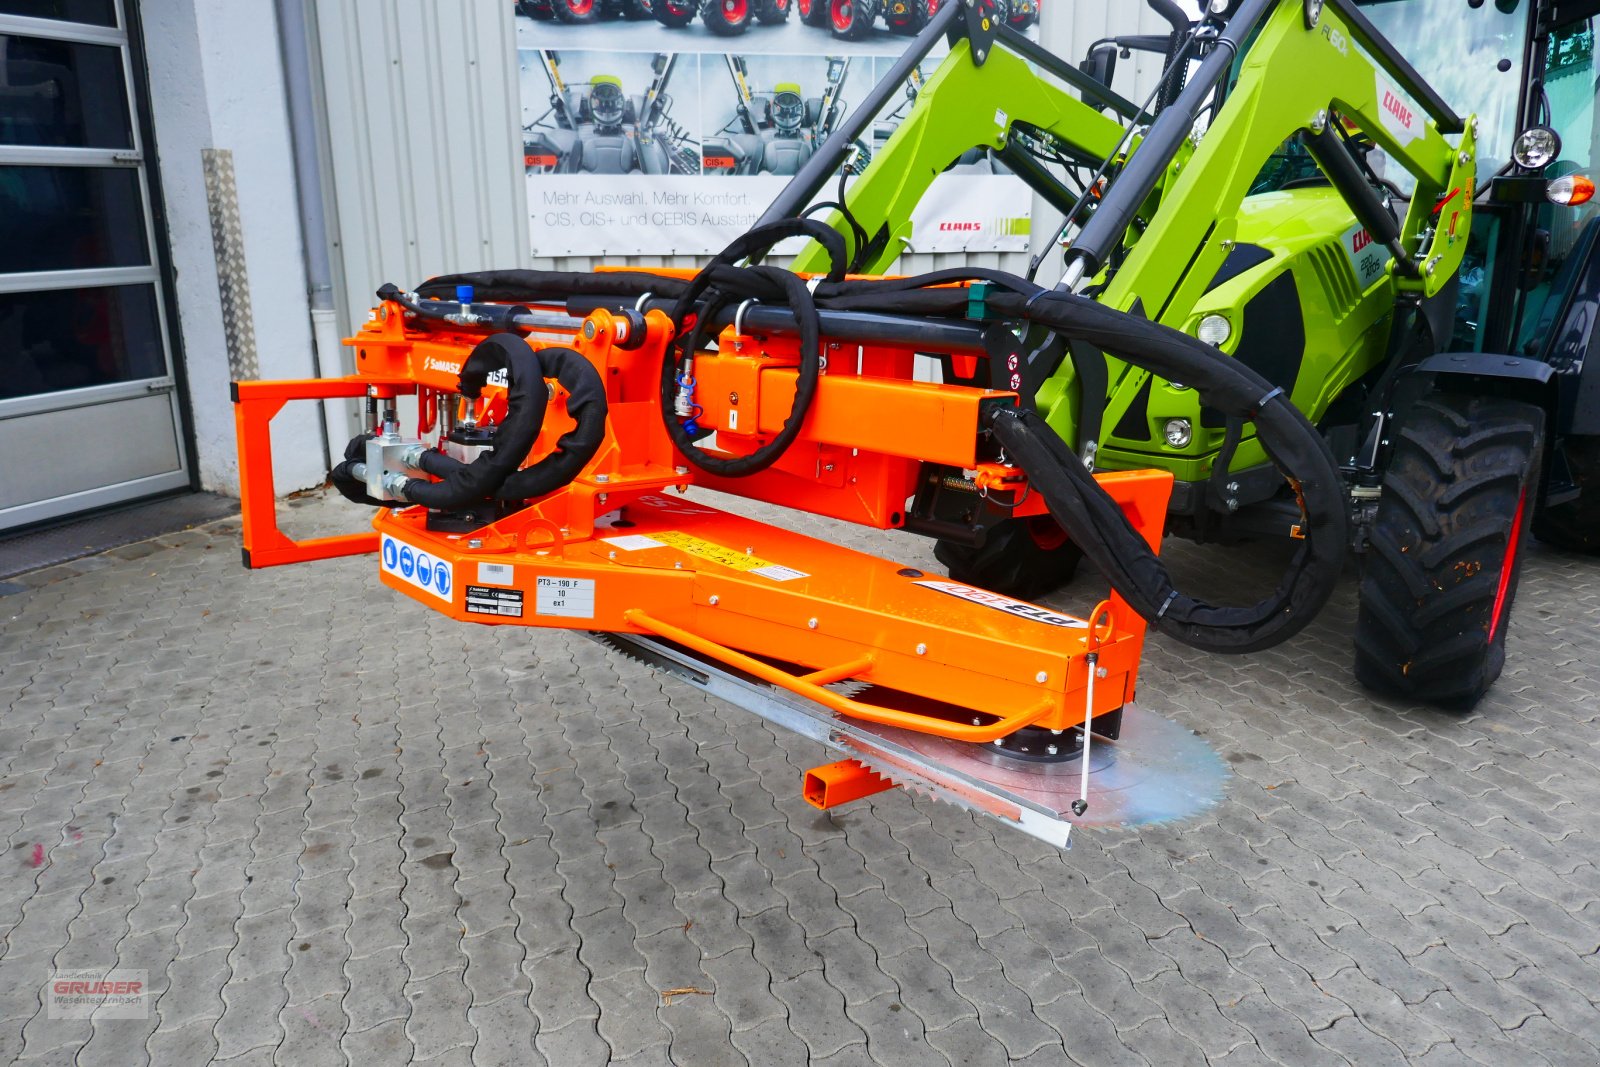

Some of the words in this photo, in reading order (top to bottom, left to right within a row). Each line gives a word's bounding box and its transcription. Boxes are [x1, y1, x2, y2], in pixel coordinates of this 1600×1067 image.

[1382, 90, 1412, 129] CLAAS
[527, 157, 542, 165] CIS
[705, 158, 725, 167] CIS+
[543, 191, 580, 205] Mehr
[653, 191, 689, 205] Mehr
[579, 211, 616, 226] CIS+
[620, 212, 648, 226] und
[651, 211, 697, 226] CEBIS
[939, 222, 982, 231] CLAAS
[1360, 254, 1373, 271] 220
[430, 358, 461, 375] SaMASZ
[573, 580, 579, 588] F
